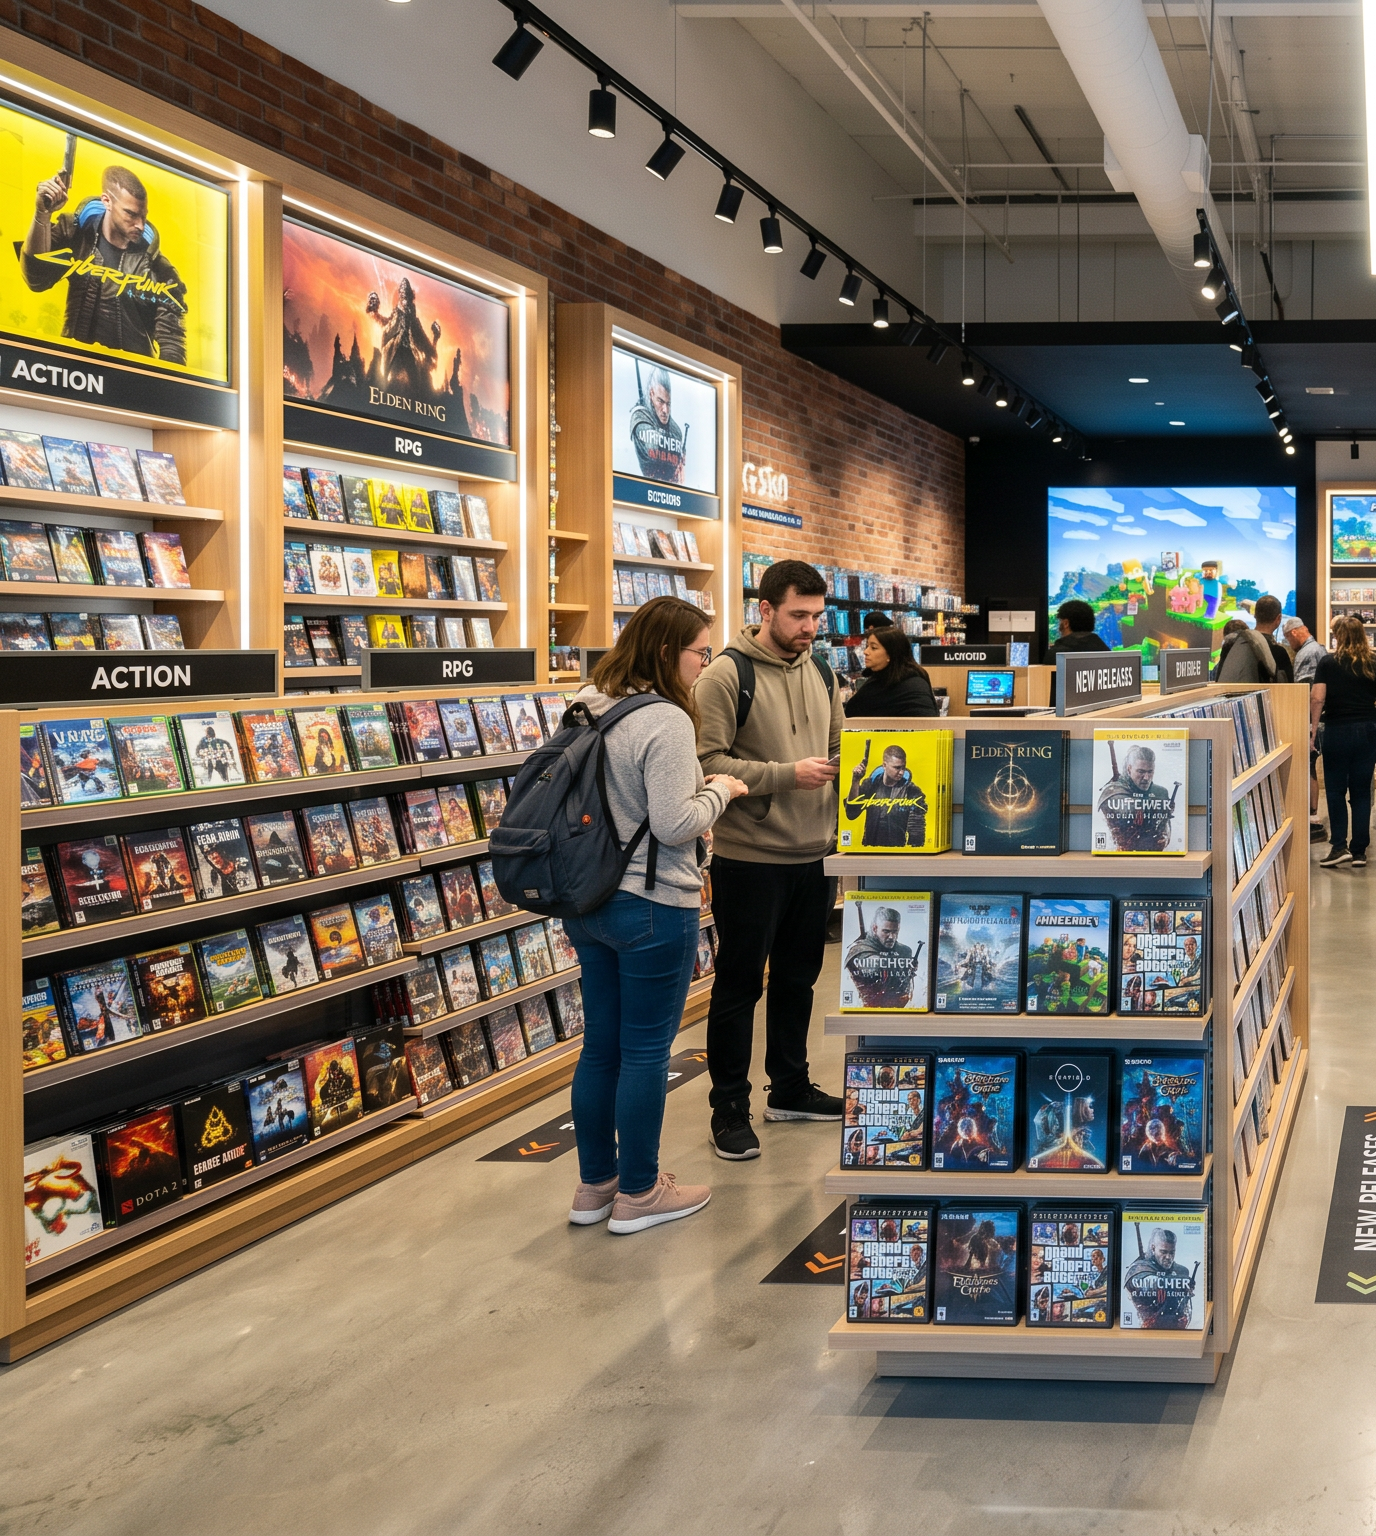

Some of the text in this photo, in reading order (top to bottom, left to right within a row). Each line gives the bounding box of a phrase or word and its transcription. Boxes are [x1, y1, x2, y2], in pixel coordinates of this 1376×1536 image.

[12, 358, 104, 395] ACTION
[369, 386, 446, 422] ELDEN RING
[395, 436, 423, 457] RPG
[91, 664, 192, 690] ACTION
[441, 659, 474, 678] RPG
[1075, 669, 1096, 693] NEW
[971, 745, 1052, 759] ELDEN RING
[135, 1181, 179, 1207] DOTA 2
